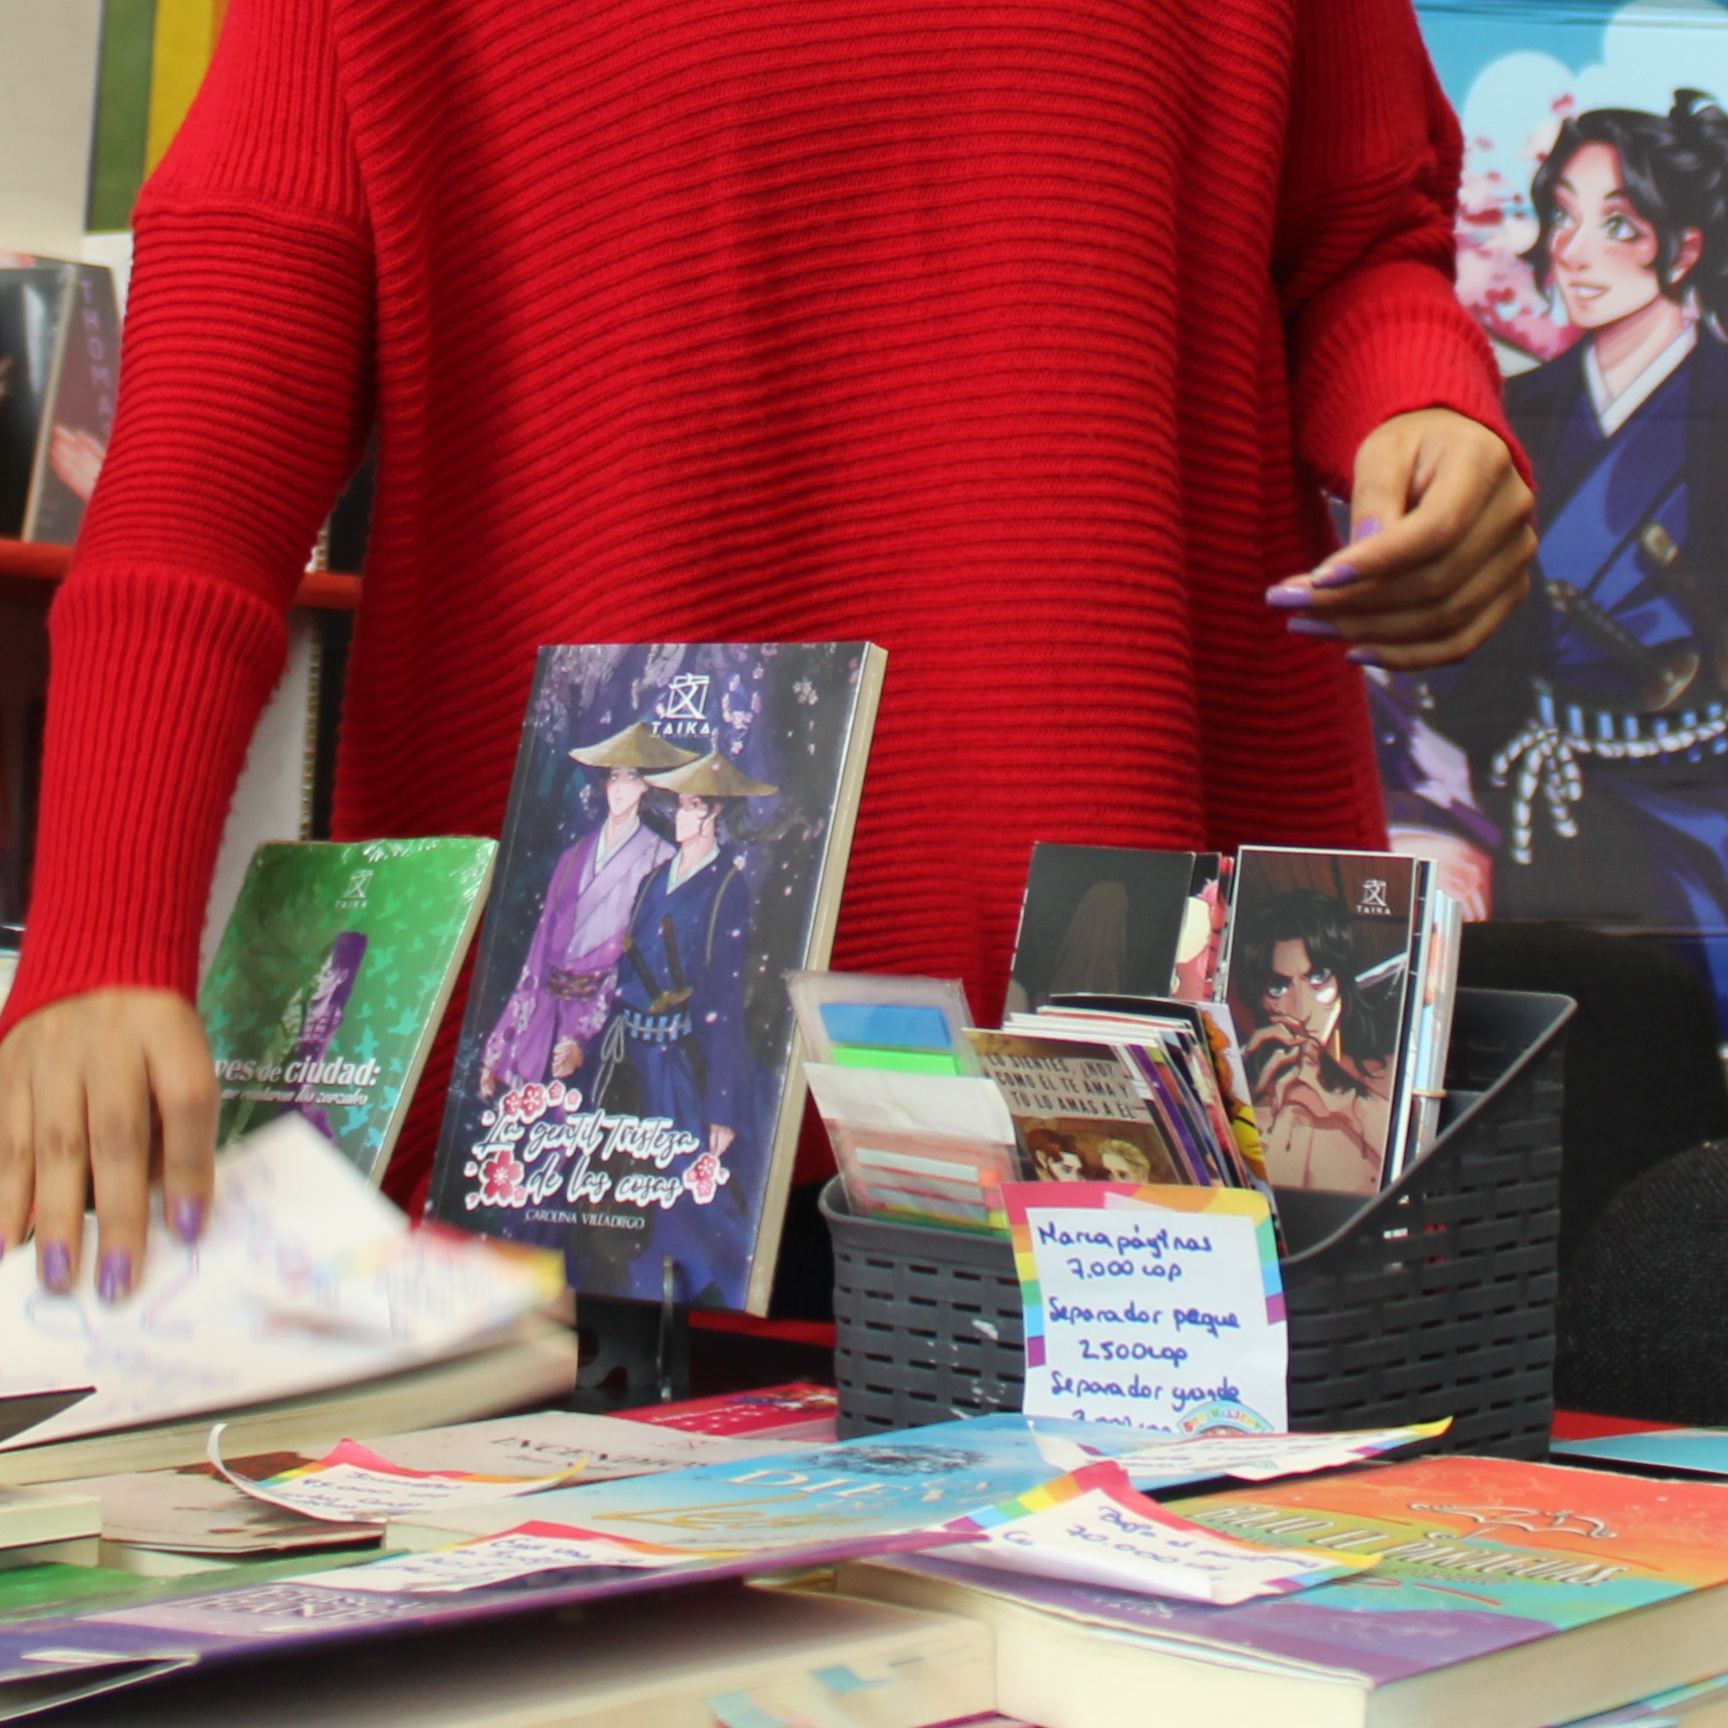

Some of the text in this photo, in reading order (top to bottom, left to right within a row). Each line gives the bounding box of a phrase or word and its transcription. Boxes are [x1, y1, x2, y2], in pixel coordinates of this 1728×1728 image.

[651, 721, 711, 735] TAIKA
[1355, 903, 1393, 916] TAIKA
[215, 1056, 382, 1087] ves de ciudad:
[995, 1070, 1036, 1089] COMO
[1061, 1077, 1080, 1094] TE
[1083, 1079, 1117, 1098] AMA
[1058, 1096, 1100, 1115] AMAS
[1102, 1101, 1115, 1117] A
[524, 1109, 606, 1163] gentil
[526, 1152, 685, 1210] de las cosas
[524, 1208, 578, 1224] CAROLINA
[1067, 1257, 1135, 1280] 7.000
[1048, 1295, 1164, 1326] Separador
[1051, 1370, 1164, 1399] Separador
[1186, 1503, 1337, 1535] BAJO
[1309, 1527, 1391, 1550] EL
[1367, 1540, 1631, 1587] PARAGUAS
